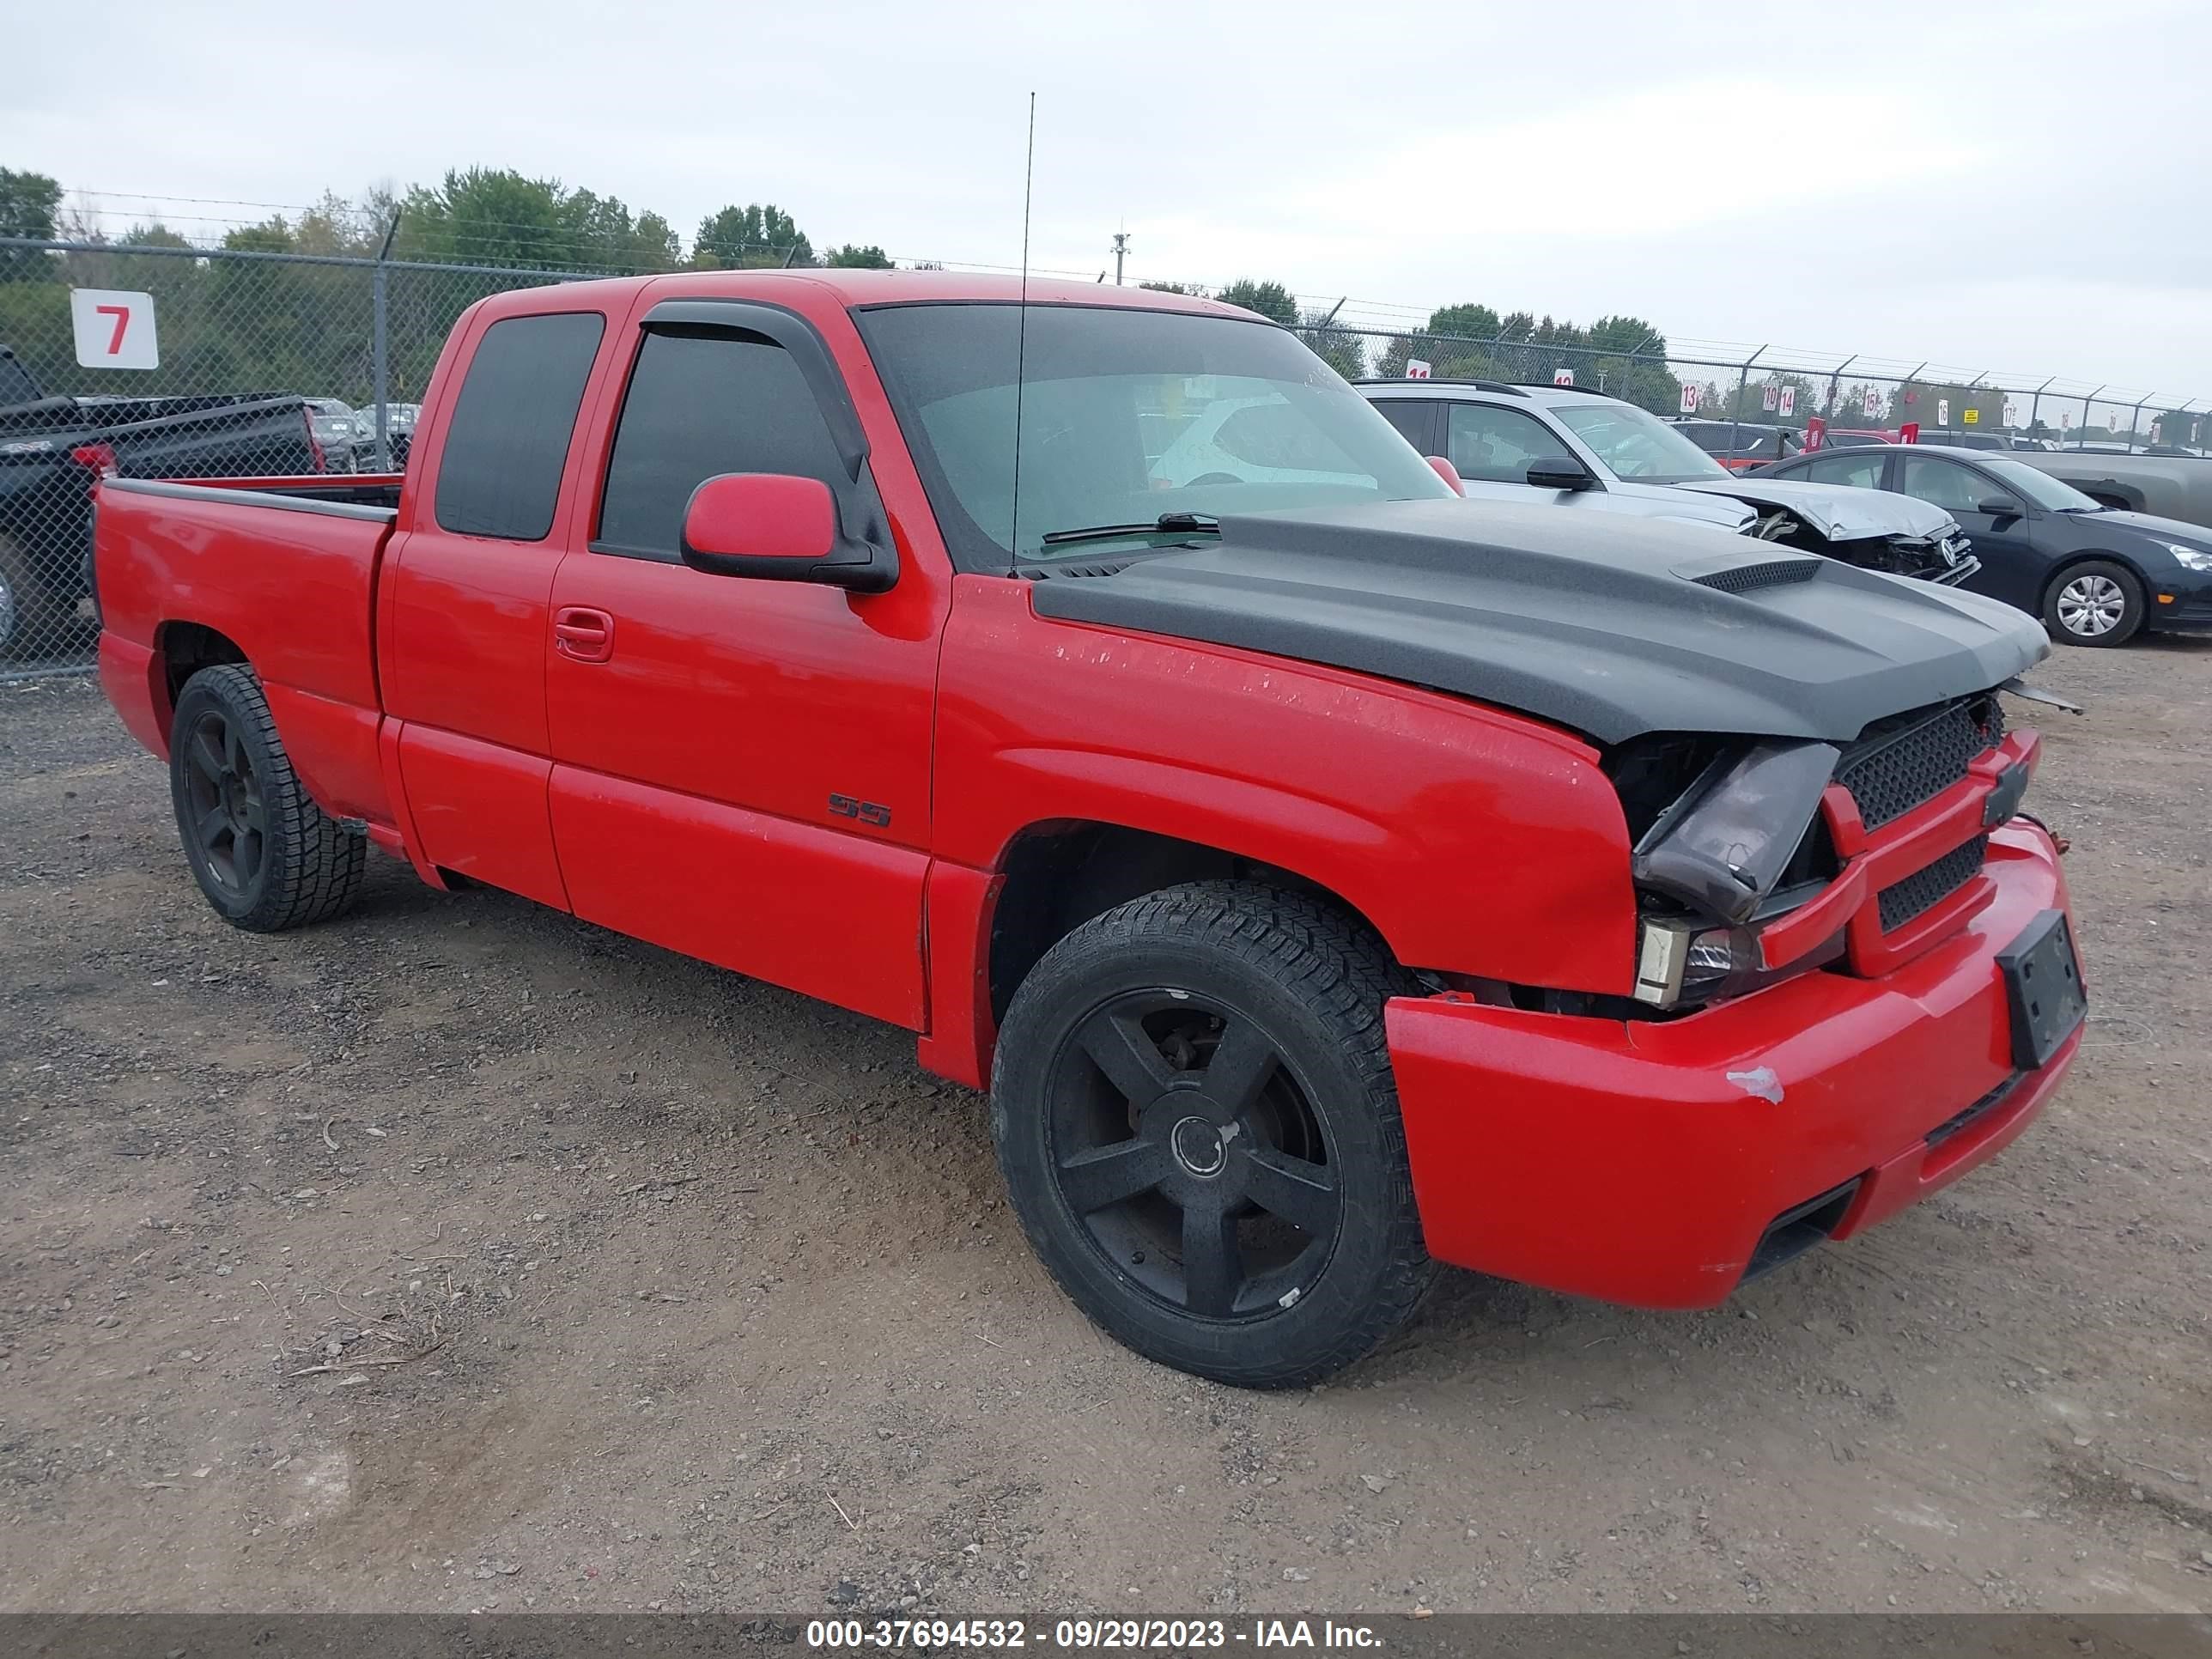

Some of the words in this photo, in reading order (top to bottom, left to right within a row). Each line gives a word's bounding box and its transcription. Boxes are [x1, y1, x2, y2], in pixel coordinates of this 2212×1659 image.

[96, 305, 131, 356] 7
[1683, 386, 1696, 408] 13
[1766, 386, 1778, 405] 10
[1782, 392, 1793, 412] 14
[1866, 393, 1875, 413] 15
[1939, 404, 1948, 422] 16
[2004, 407, 2014, 424] 17
[829, 792, 891, 828] SS
